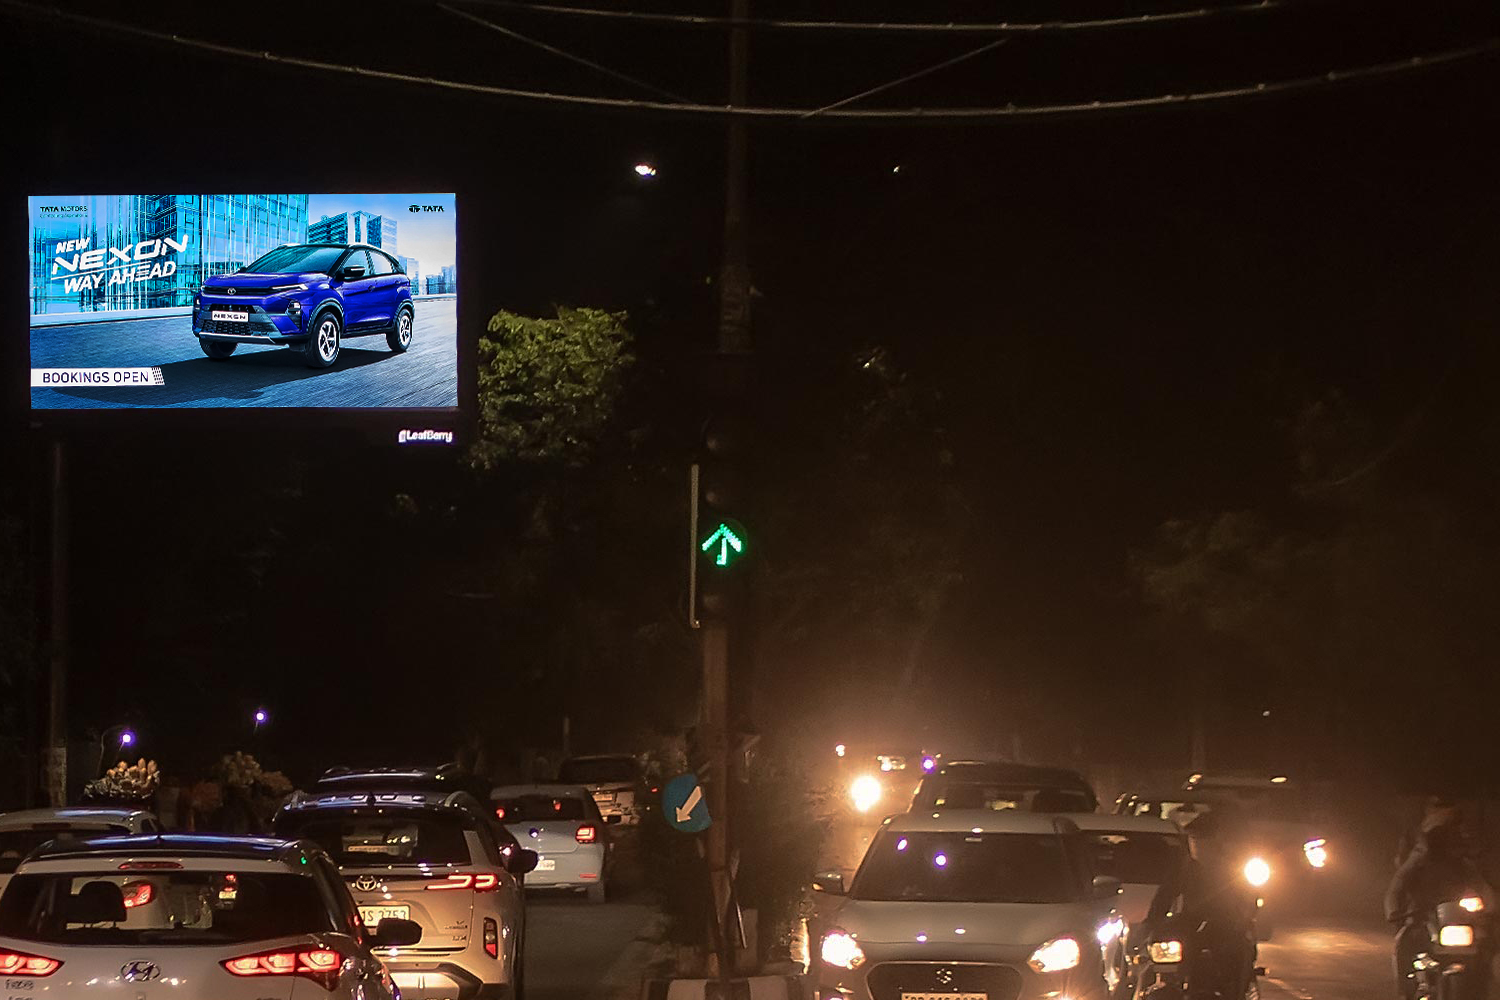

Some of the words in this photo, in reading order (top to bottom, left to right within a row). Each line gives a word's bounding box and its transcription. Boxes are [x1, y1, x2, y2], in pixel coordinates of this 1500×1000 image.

[51, 234, 189, 275] NEXON
[55, 237, 91, 254] NEW
[64, 273, 105, 294] WAY
[108, 261, 177, 287] AHEAD
[42, 371, 110, 383] BOOKINGS
[113, 371, 149, 383] OPEN
